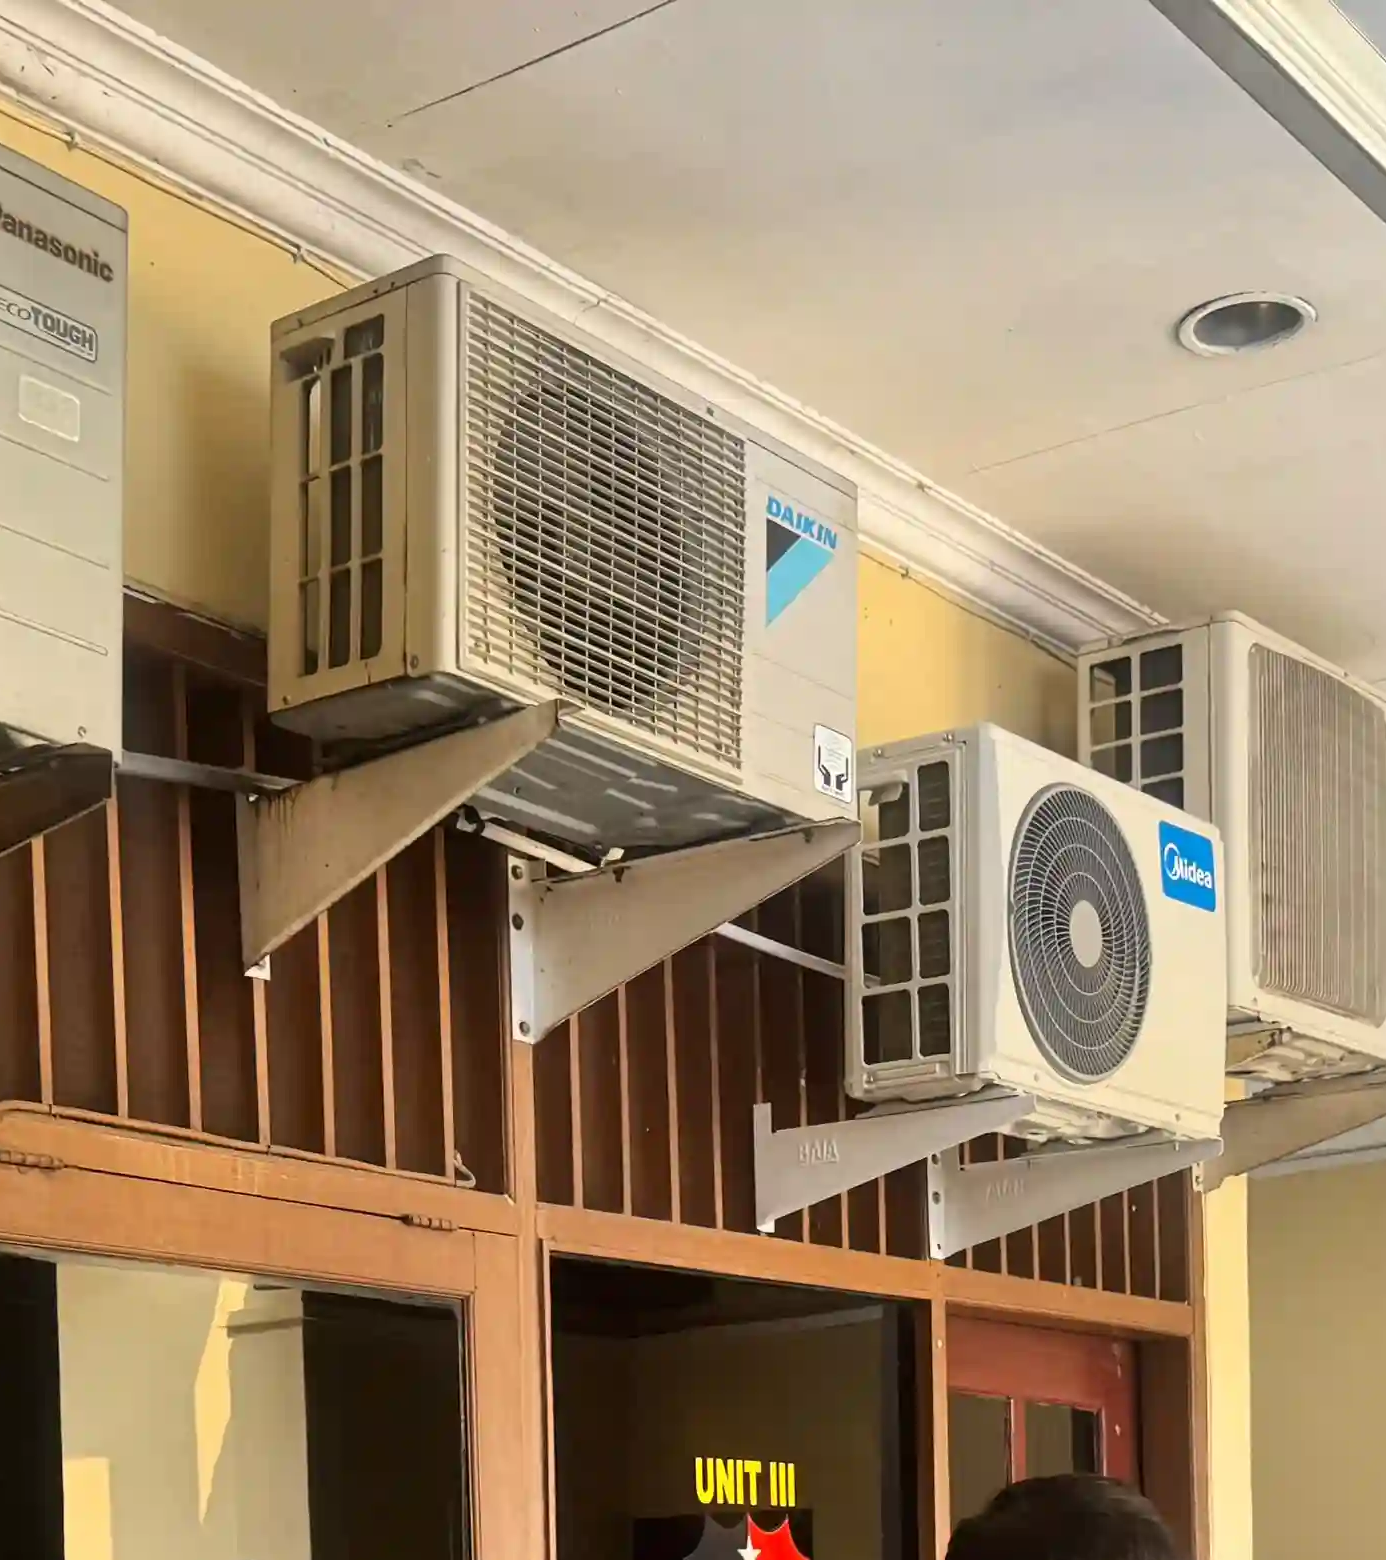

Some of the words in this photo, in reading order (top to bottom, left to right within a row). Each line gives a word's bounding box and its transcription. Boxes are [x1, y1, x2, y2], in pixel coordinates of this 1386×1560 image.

[765, 495, 839, 551] DAIKIN
[1164, 842, 1213, 889] Midea
[695, 1456, 762, 1506] UNIT
[769, 1462, 796, 1508] III
